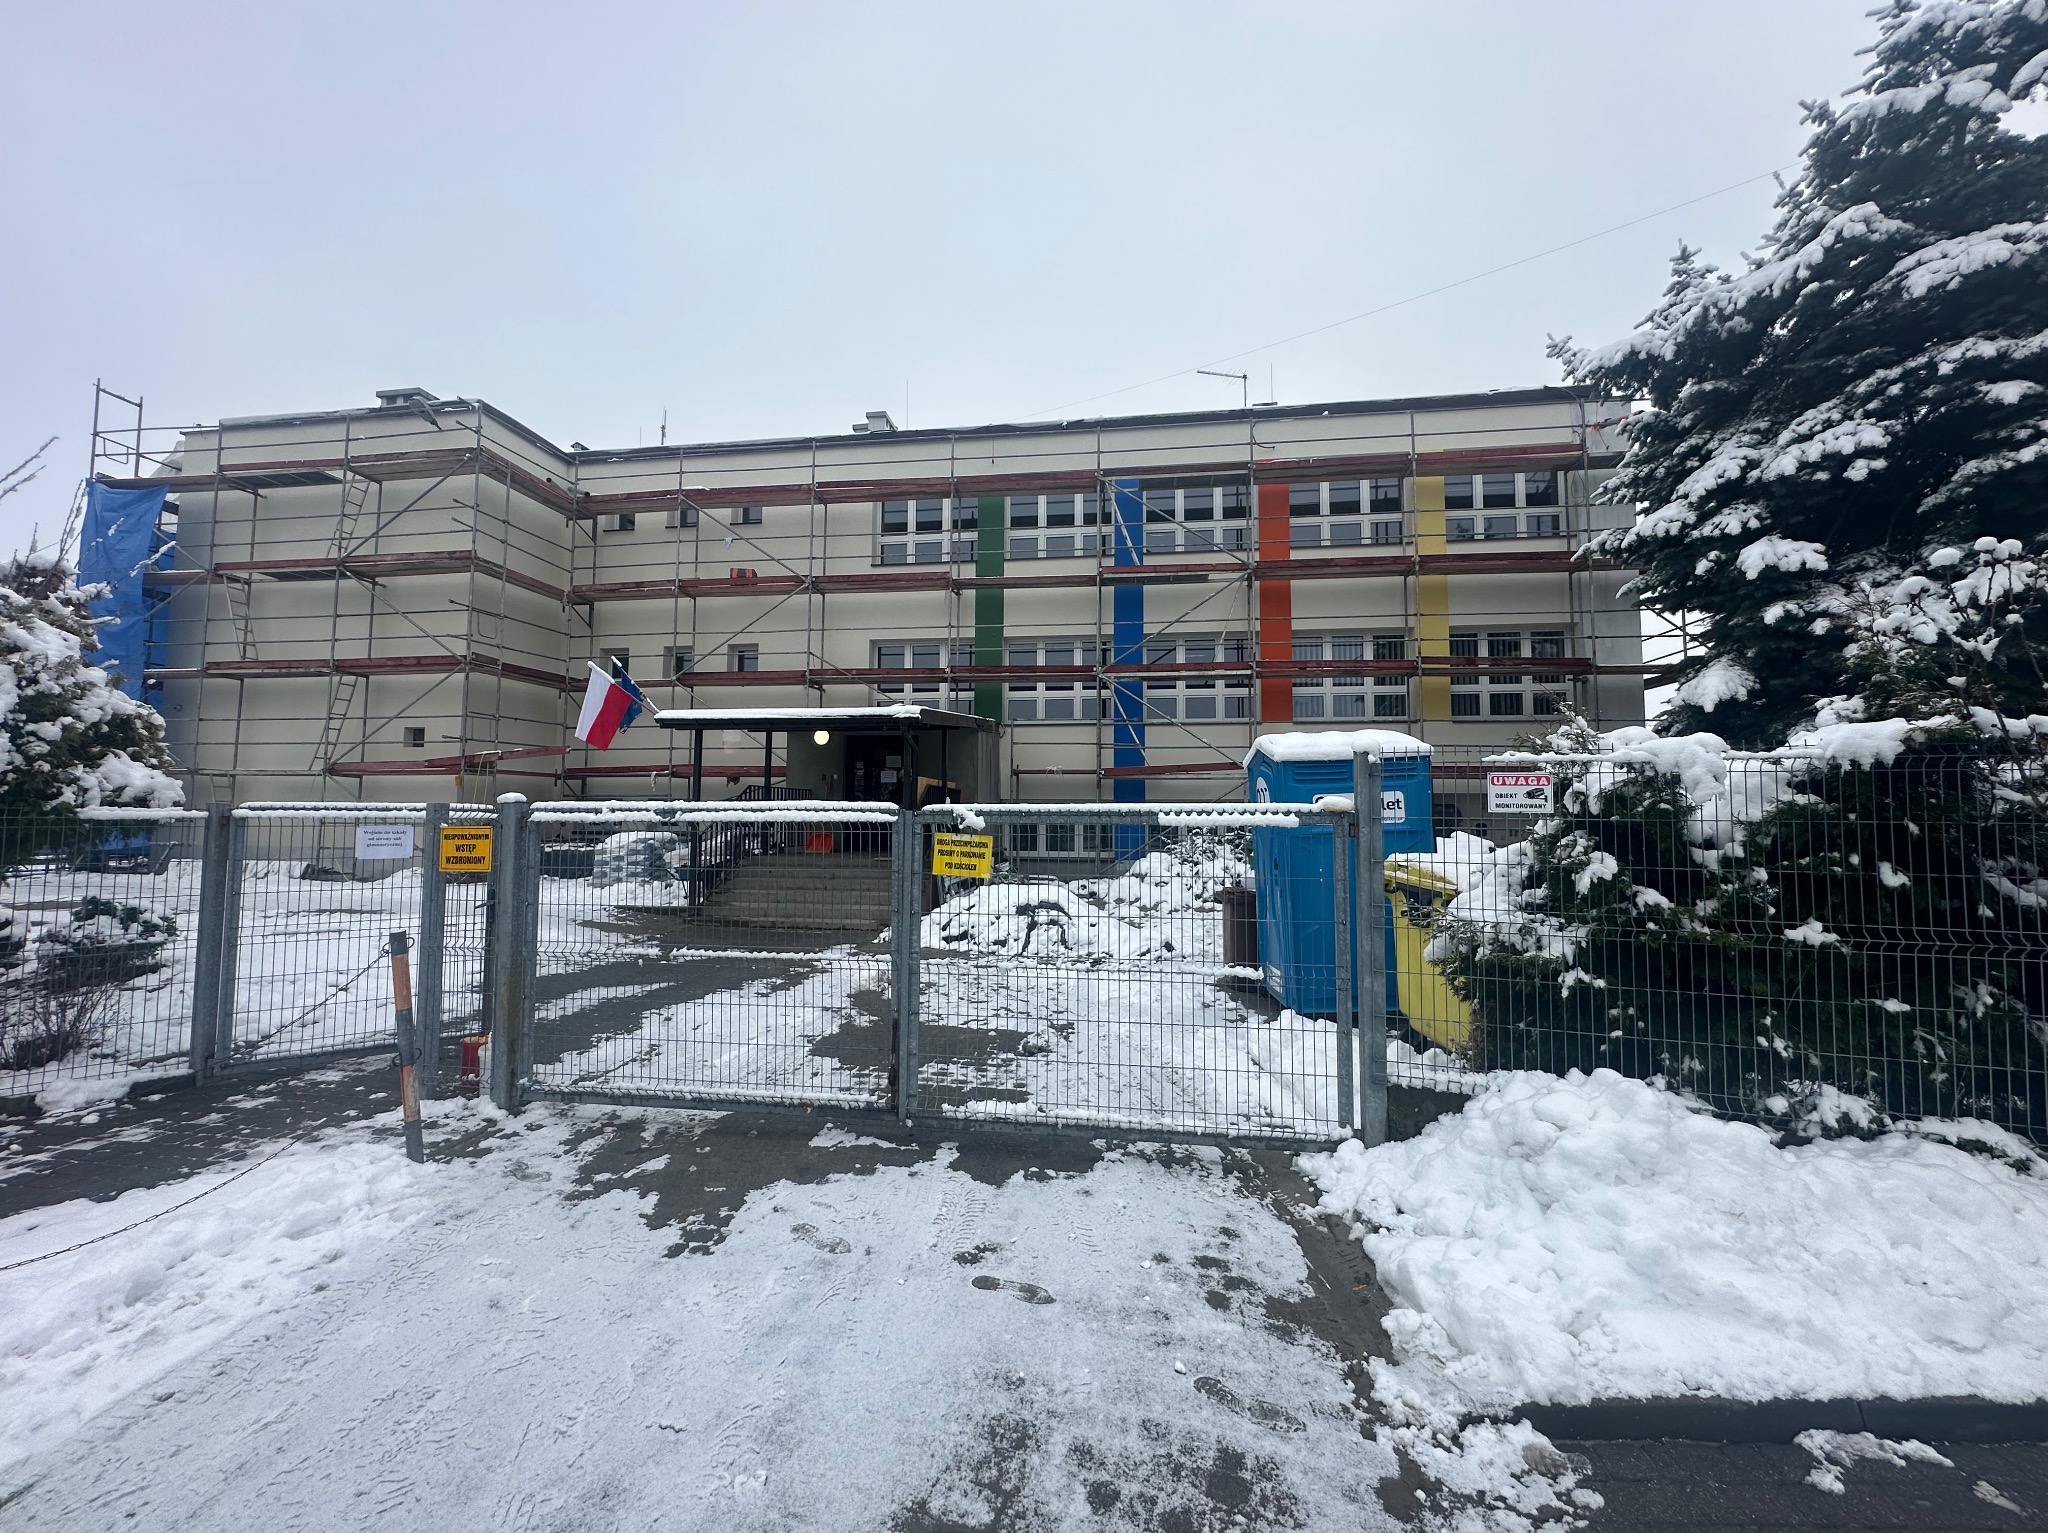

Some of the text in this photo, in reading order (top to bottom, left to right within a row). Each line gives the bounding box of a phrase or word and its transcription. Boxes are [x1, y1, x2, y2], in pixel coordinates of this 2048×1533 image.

[1493, 776, 1549, 786] UWAGA
[937, 838, 950, 846] DROGA
[455, 843, 476, 854] WSTĘP
[938, 849, 955, 857] PROSIMY
[960, 850, 986, 859] PARKOWANIE
[445, 855, 486, 864] WZBRONIONY
